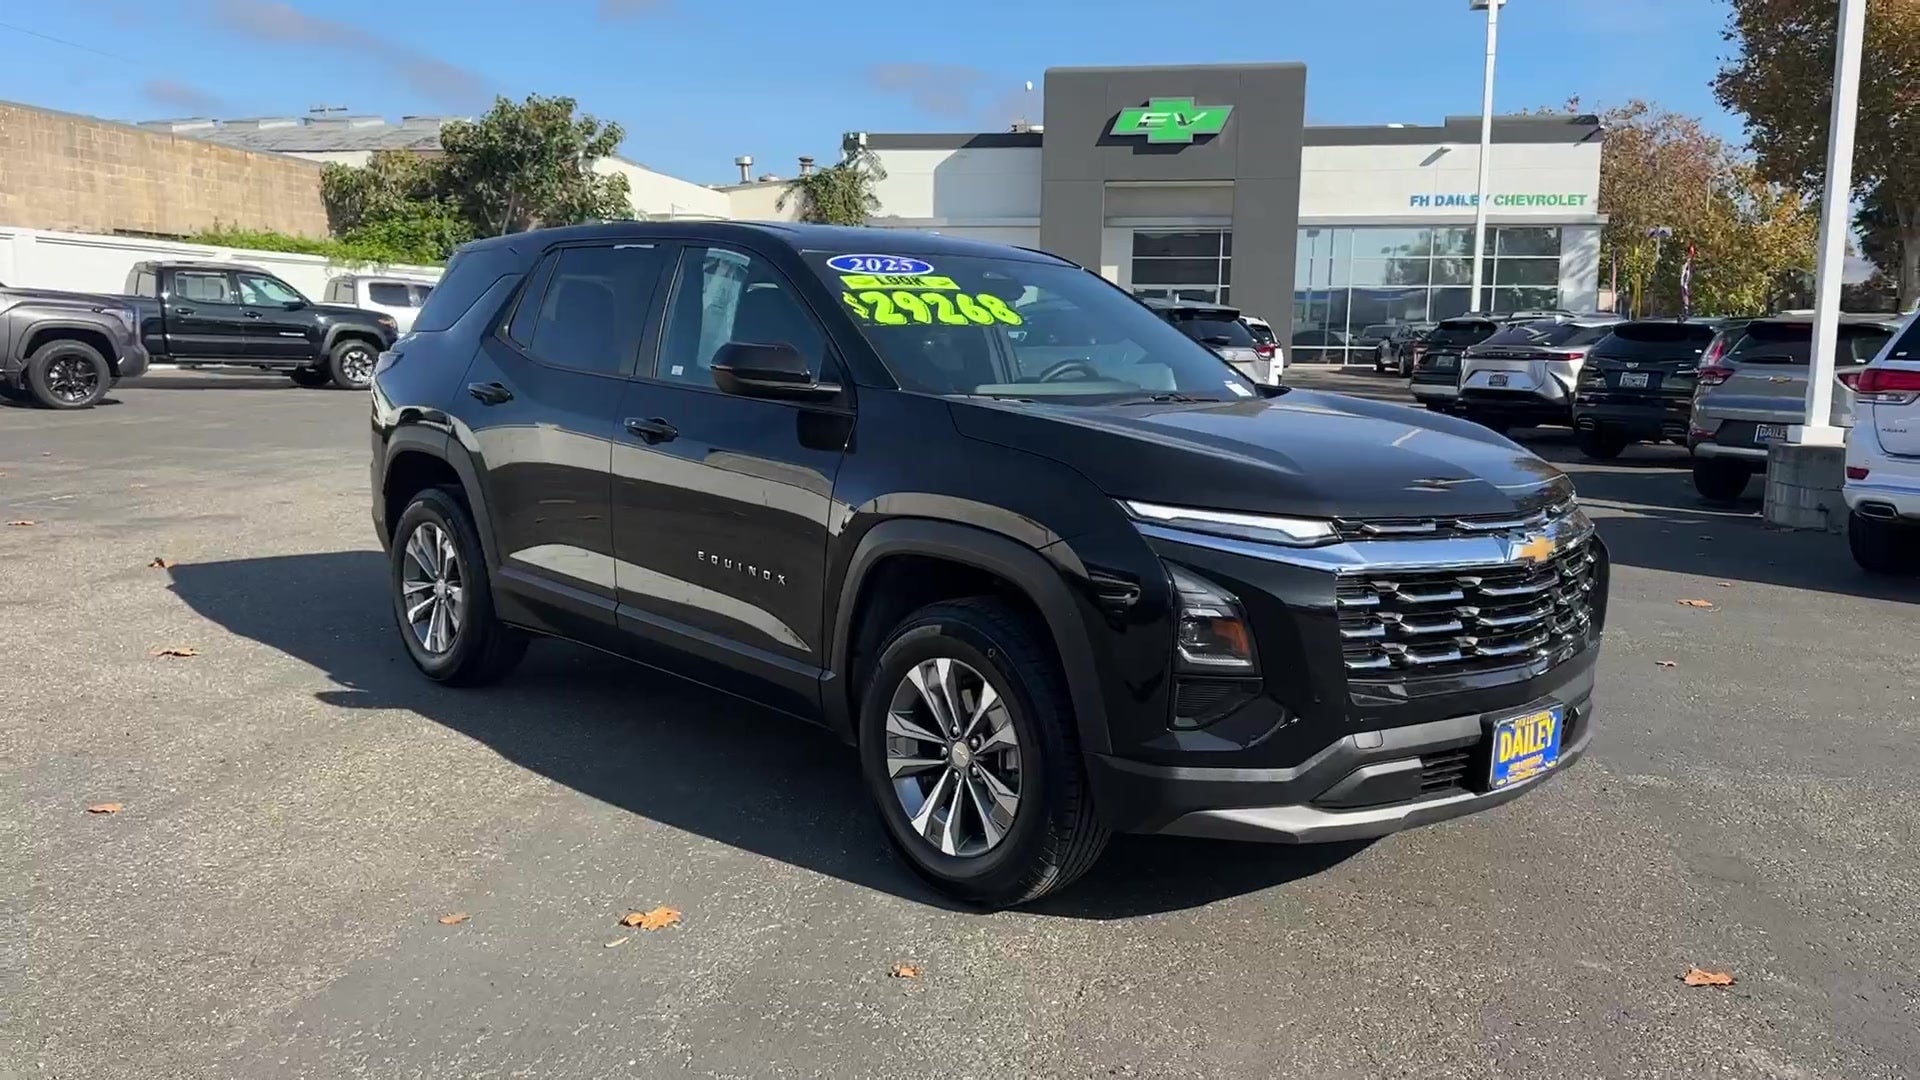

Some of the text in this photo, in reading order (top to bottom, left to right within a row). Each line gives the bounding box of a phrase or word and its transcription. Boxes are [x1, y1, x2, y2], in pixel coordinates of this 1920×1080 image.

[1136, 112, 1207, 129] EV
[1410, 194, 1430, 207] FH
[1494, 193, 1588, 207] CHEVROLET
[849, 257, 914, 272] 2025
[873, 274, 926, 287] LOOK
[842, 290, 1023, 326] $29268
[1758, 426, 1787, 440] DAILE
[697, 550, 786, 586] EQUINOX
[1499, 716, 1557, 764] DAILEY
